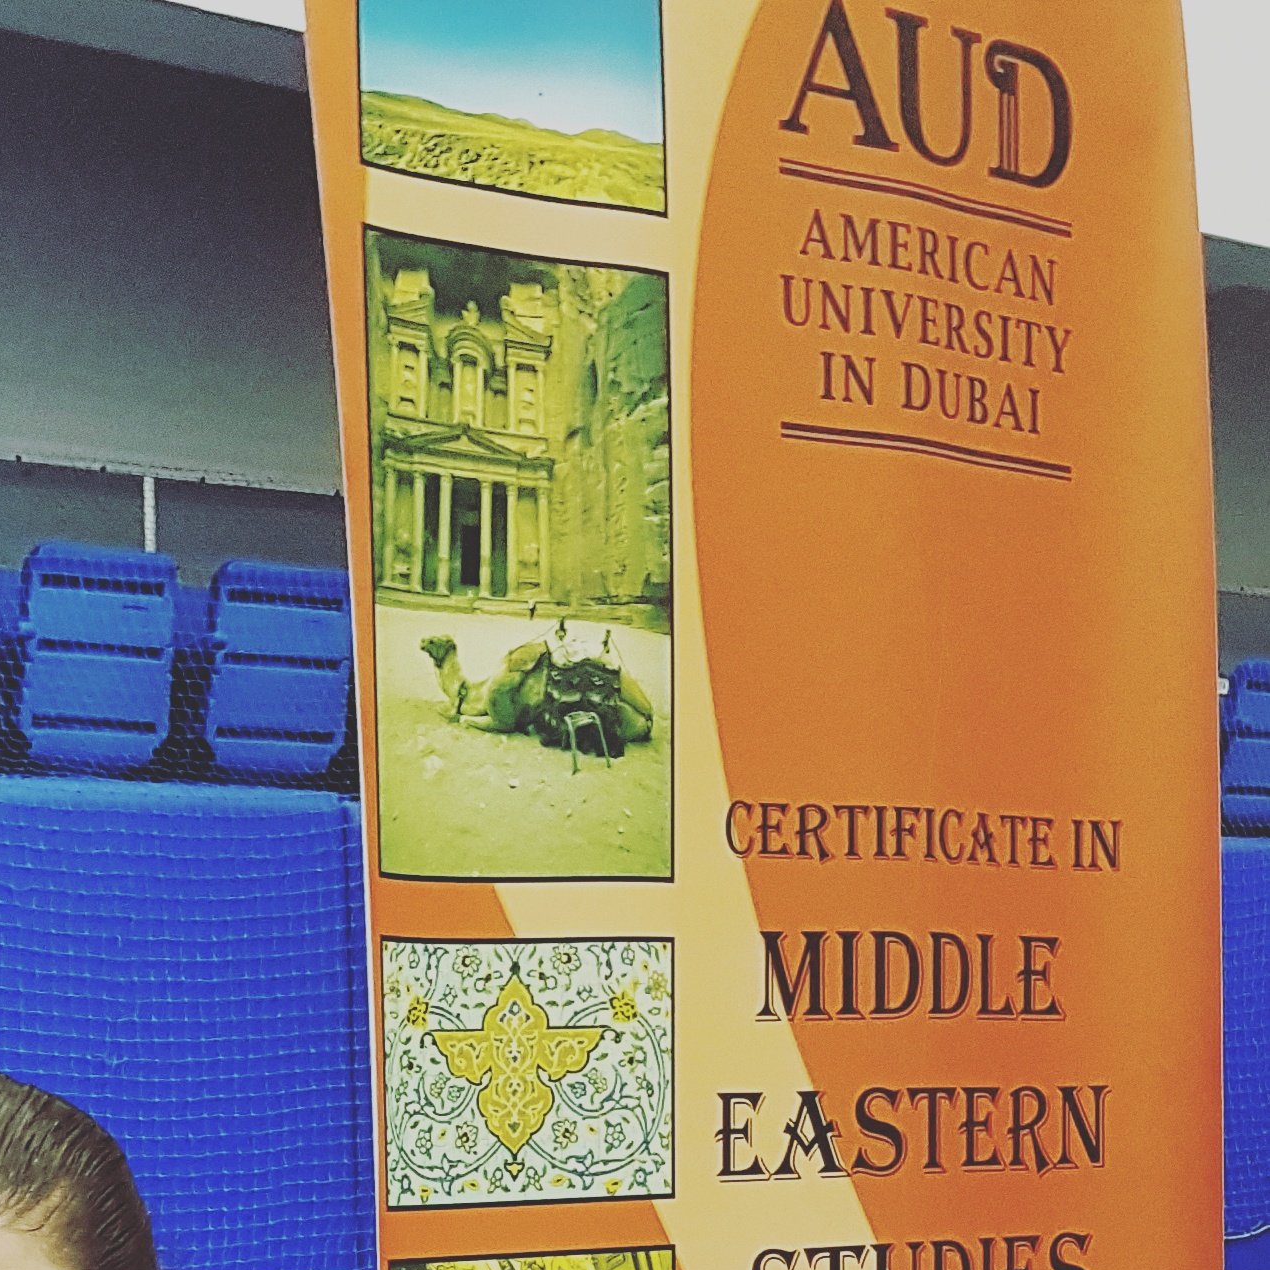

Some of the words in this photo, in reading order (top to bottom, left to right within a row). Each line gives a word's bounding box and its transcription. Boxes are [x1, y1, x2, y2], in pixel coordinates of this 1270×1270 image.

[778, 0, 1073, 189] AUD
[799, 208, 1058, 306] AMERICAN
[780, 274, 1072, 374] UNIVERSITY
[820, 351, 876, 406] IN
[901, 361, 1041, 435] DUBAI
[725, 799, 1058, 870] CERTIFICATE
[1071, 819, 1123, 872] IN
[755, 930, 1067, 1022] MIDDLE
[715, 1084, 1112, 1182] EASTERN
